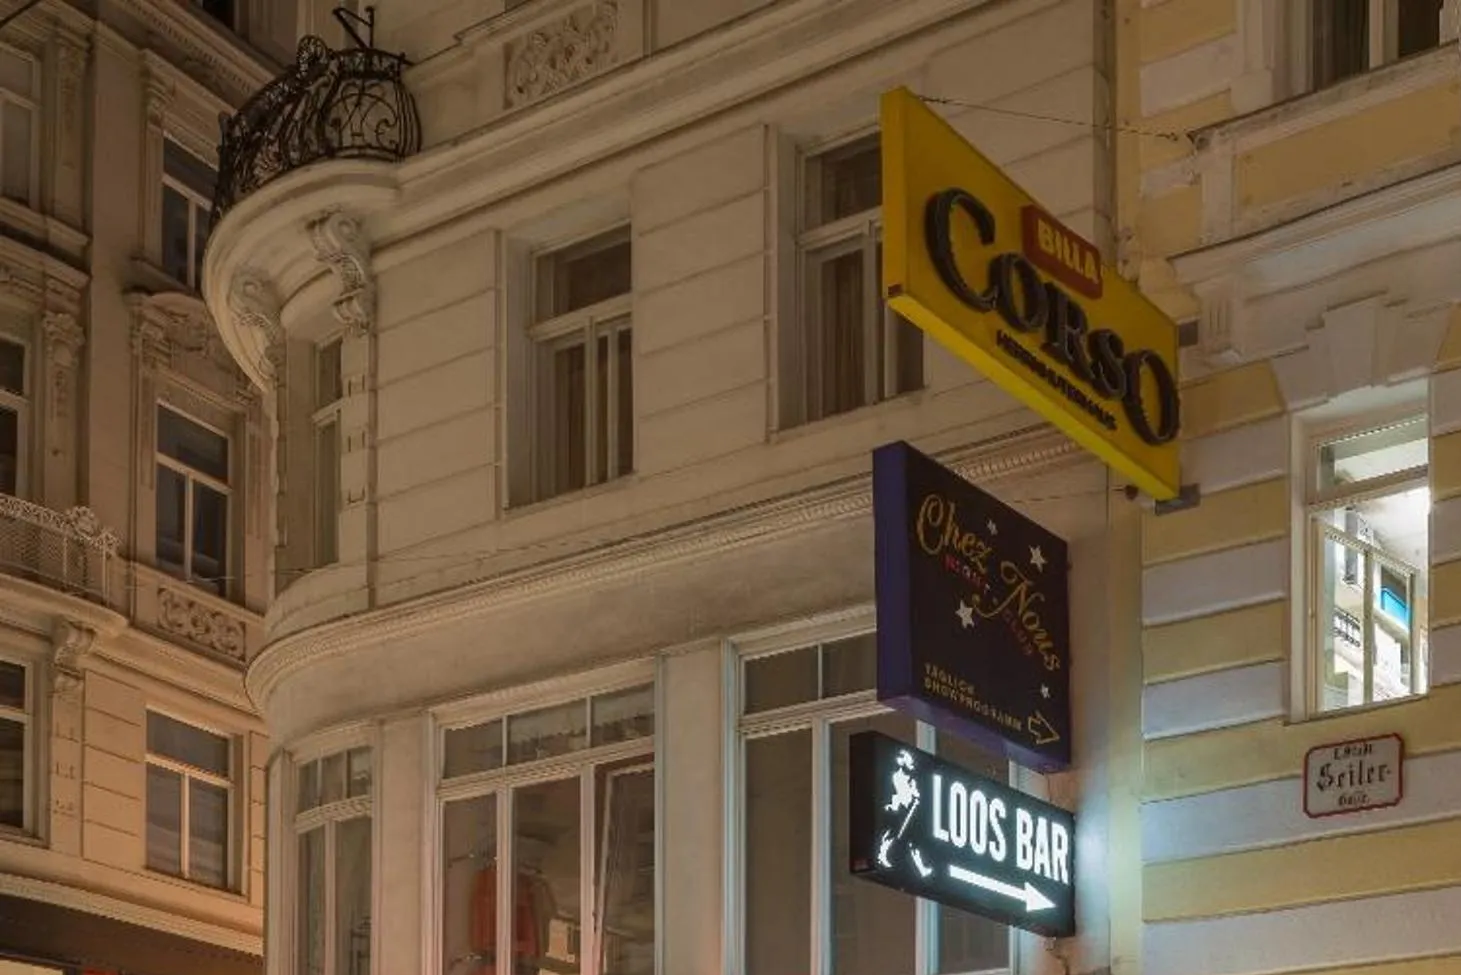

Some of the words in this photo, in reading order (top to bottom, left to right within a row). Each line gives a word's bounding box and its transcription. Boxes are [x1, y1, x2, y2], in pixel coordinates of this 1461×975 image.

[1038, 218, 1099, 285] BILLA
[917, 494, 991, 575] Chez
[972, 561, 1061, 672] Nous
[931, 774, 1006, 865] LOOS
[1015, 806, 1070, 885] BAR
